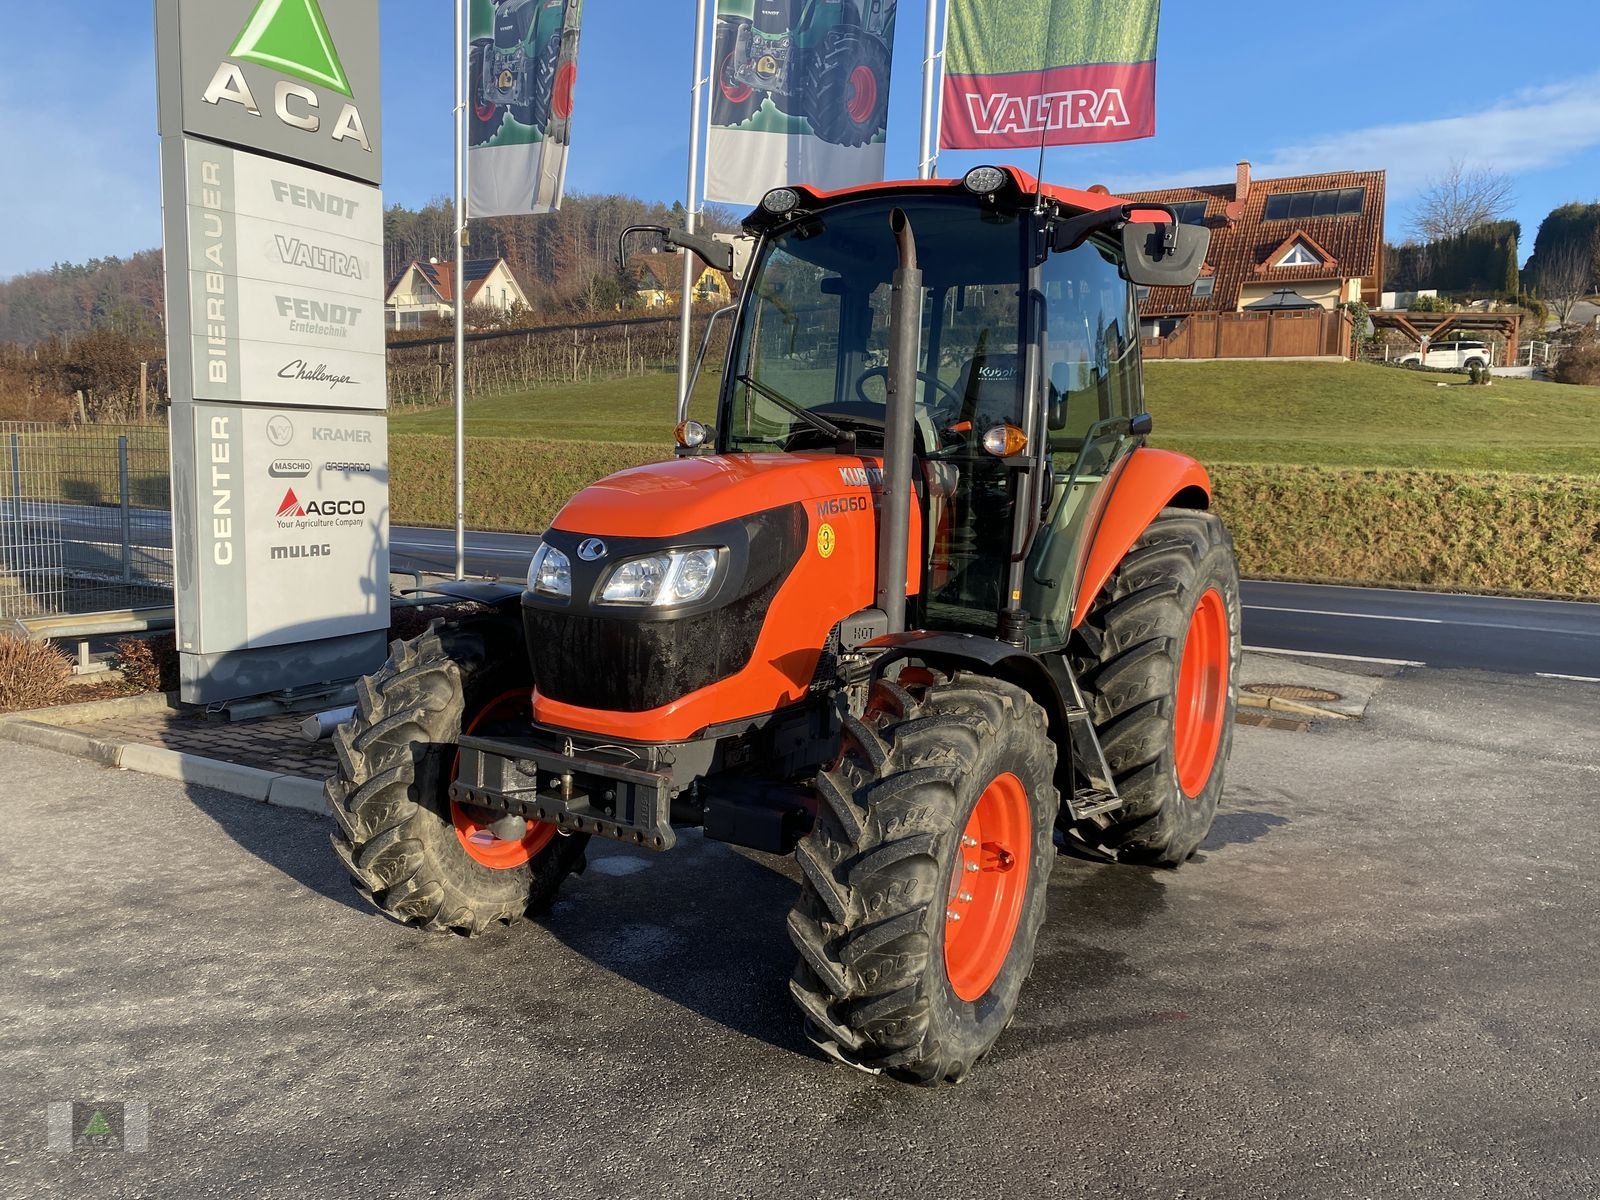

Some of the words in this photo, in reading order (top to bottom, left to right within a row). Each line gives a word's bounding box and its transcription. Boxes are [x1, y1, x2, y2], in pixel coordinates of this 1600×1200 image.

[201, 61, 373, 153] ACA
[965, 88, 1131, 135] VALTRA
[271, 179, 359, 220] FENDT
[274, 234, 362, 280] VALTRA
[202, 160, 228, 384] BIERBAUER
[275, 295, 362, 326] FENDT
[289, 319, 348, 338] Erntetechnik
[277, 359, 361, 390] Challenger
[312, 426, 373, 443] KRAMER
[274, 462, 311, 471] MASCHIO
[325, 461, 371, 472] GASPARDO
[838, 466, 884, 486] KUBOT
[211, 416, 233, 566] CENTER
[305, 500, 366, 516] AGCO
[816, 496, 867, 517] M6060
[276, 519, 294, 529] Your
[295, 518, 334, 530] Agriculture
[335, 517, 364, 528] Company
[854, 627, 875, 640] HOT
